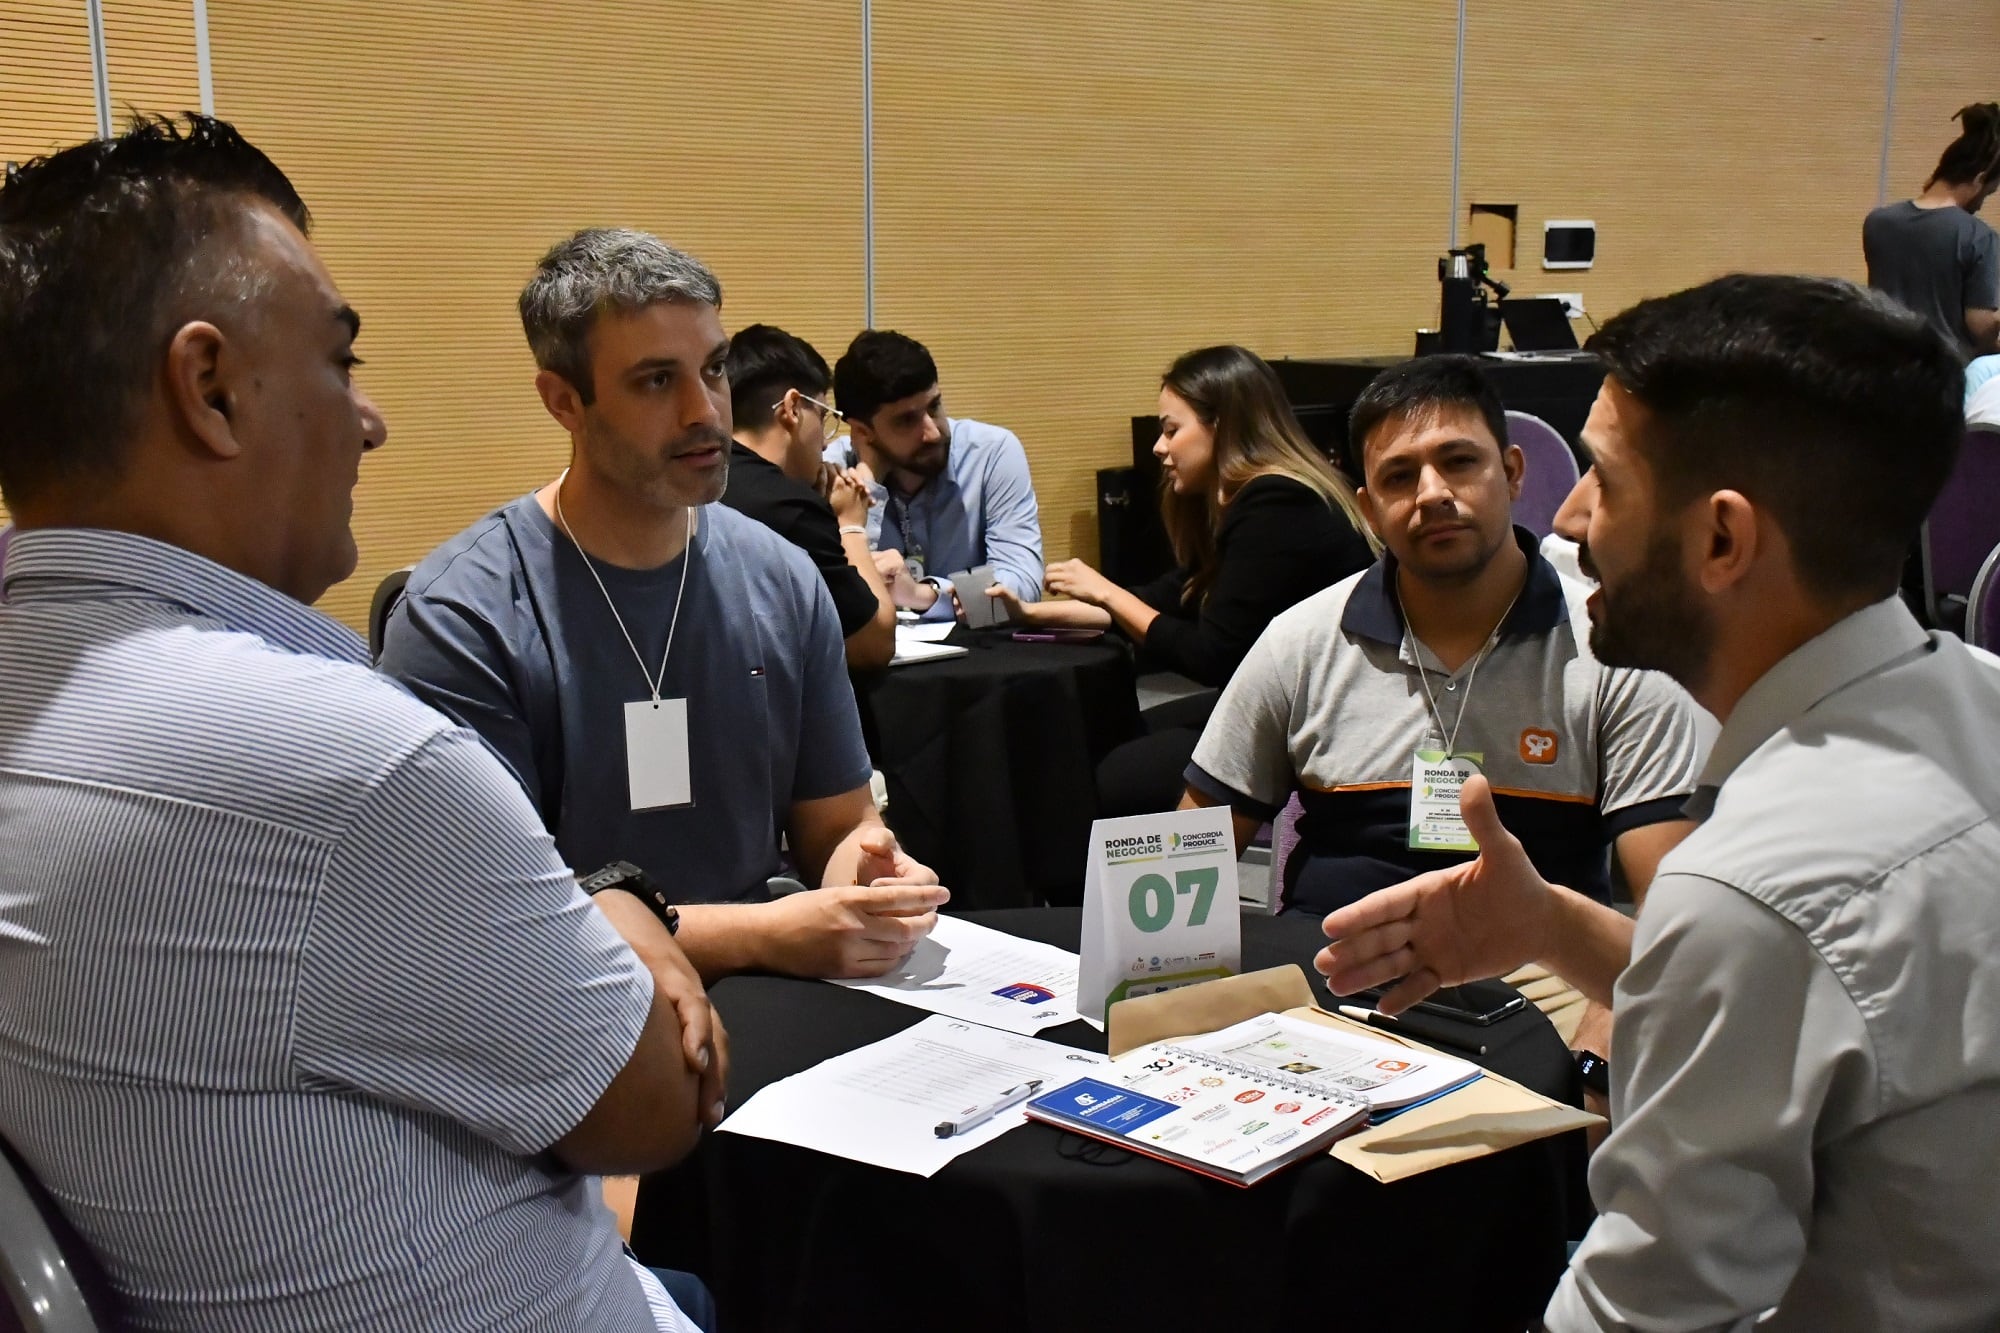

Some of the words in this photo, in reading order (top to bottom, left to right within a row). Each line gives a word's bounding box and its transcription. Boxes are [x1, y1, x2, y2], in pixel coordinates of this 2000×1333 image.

[1424, 769, 1456, 777] RONDA
[1457, 770, 1470, 778] DE
[1105, 836, 1145, 849] RONDA
[1146, 834, 1162, 845] DE
[1182, 831, 1224, 841] CONCORDIA
[1183, 839, 1217, 848] PRODUCE
[1106, 844, 1163, 859] NEGOCIOS
[1128, 866, 1219, 933] 07
